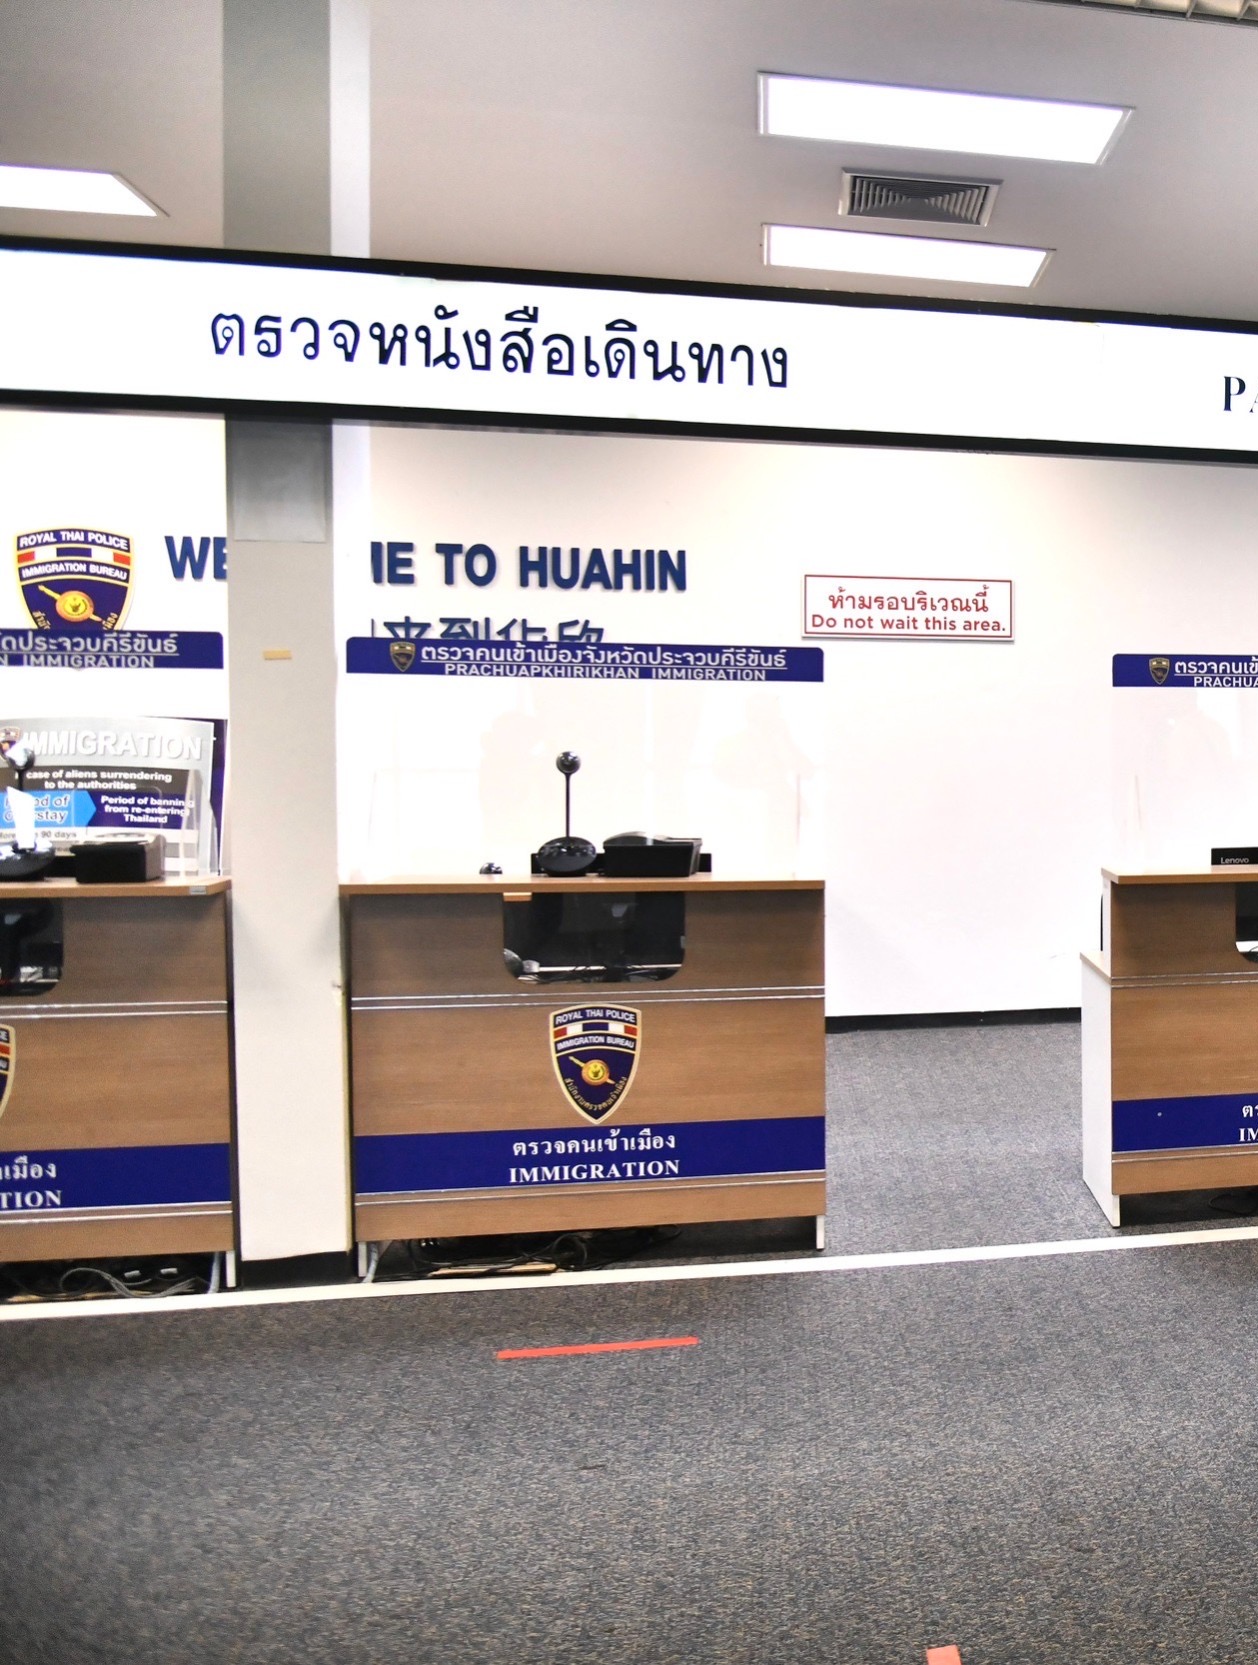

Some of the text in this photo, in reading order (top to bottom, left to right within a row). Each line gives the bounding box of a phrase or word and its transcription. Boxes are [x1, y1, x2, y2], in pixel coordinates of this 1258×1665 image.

[211, 304, 788, 388] ตรวจหนังสือเดินทาง
[19, 531, 128, 550] ROYAL THAI POLICE
[22, 562, 128, 581] IMMIGRATION BUREAU
[435, 543, 498, 586] TO
[519, 546, 687, 591] HUAHIN
[828, 584, 989, 612] ห้ามรอบริเวณนี้
[811, 614, 1006, 632] Do not wait this area.
[23, 654, 155, 668] IMMIGRATION
[445, 664, 766, 681] PRACHUAPKHIRIKHAN IMMIGRATION
[26, 771, 51, 779] case
[52, 770, 64, 779] of
[65, 770, 97, 779] aliens
[100, 771, 172, 783] surrendering
[44, 781, 136, 791] to the authorities
[101, 795, 194, 808] Period of banning
[104, 805, 189, 817] from re-entering
[124, 814, 168, 824] Thailand
[555, 1009, 635, 1024] ROYAL THAI POLICE
[557, 1036, 635, 1050] IMMIGRATION BUREAU
[512, 1128, 676, 1156] ตรวจคนเข้าเมือง
[509, 1159, 680, 1183] IMMIGRATION
